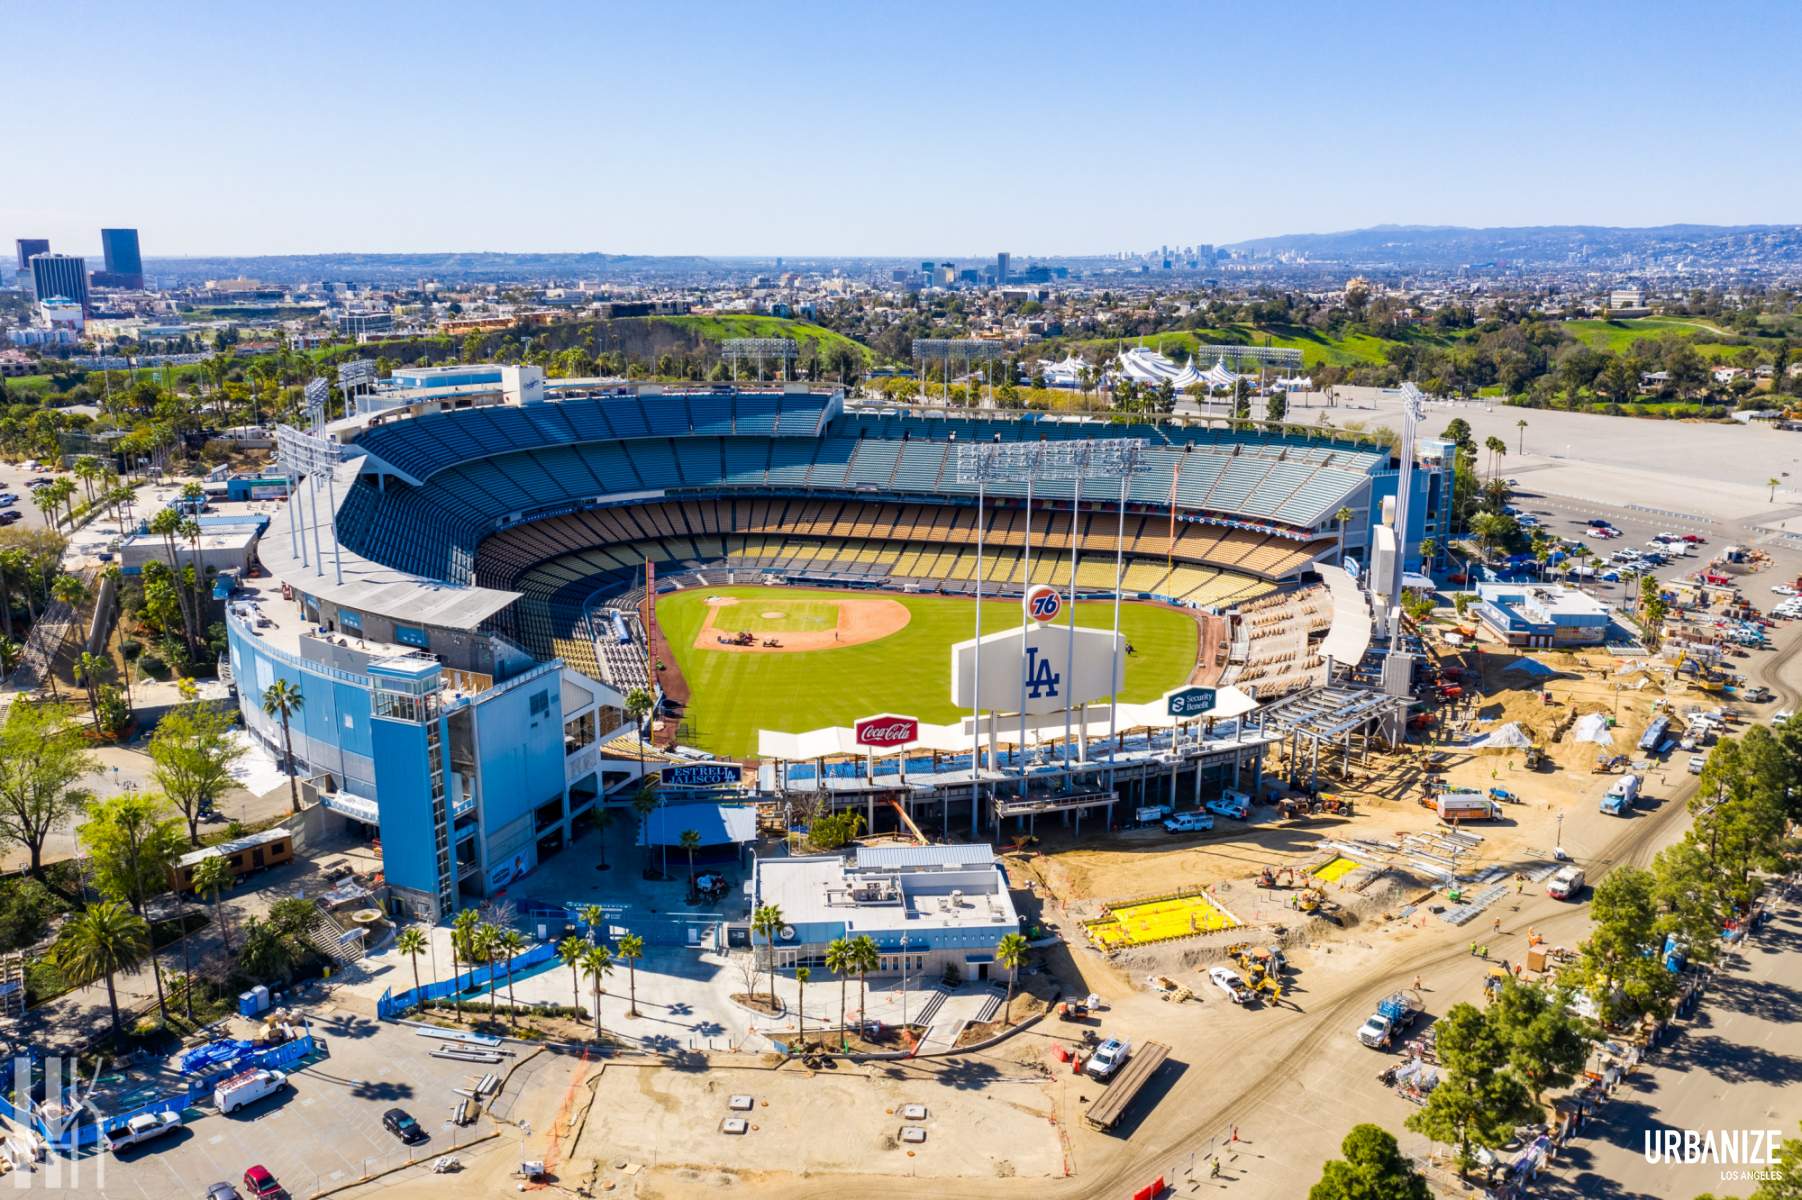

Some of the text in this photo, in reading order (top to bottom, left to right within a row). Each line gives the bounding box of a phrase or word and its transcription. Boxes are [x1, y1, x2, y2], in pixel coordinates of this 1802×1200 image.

[1033, 594, 1058, 616] 76
[1025, 647, 1060, 699] LA
[1186, 693, 1213, 704] Security
[1186, 702, 1209, 711] Benefit
[861, 723, 913, 742] Coca-Cola
[669, 775, 721, 784] JALISCO
